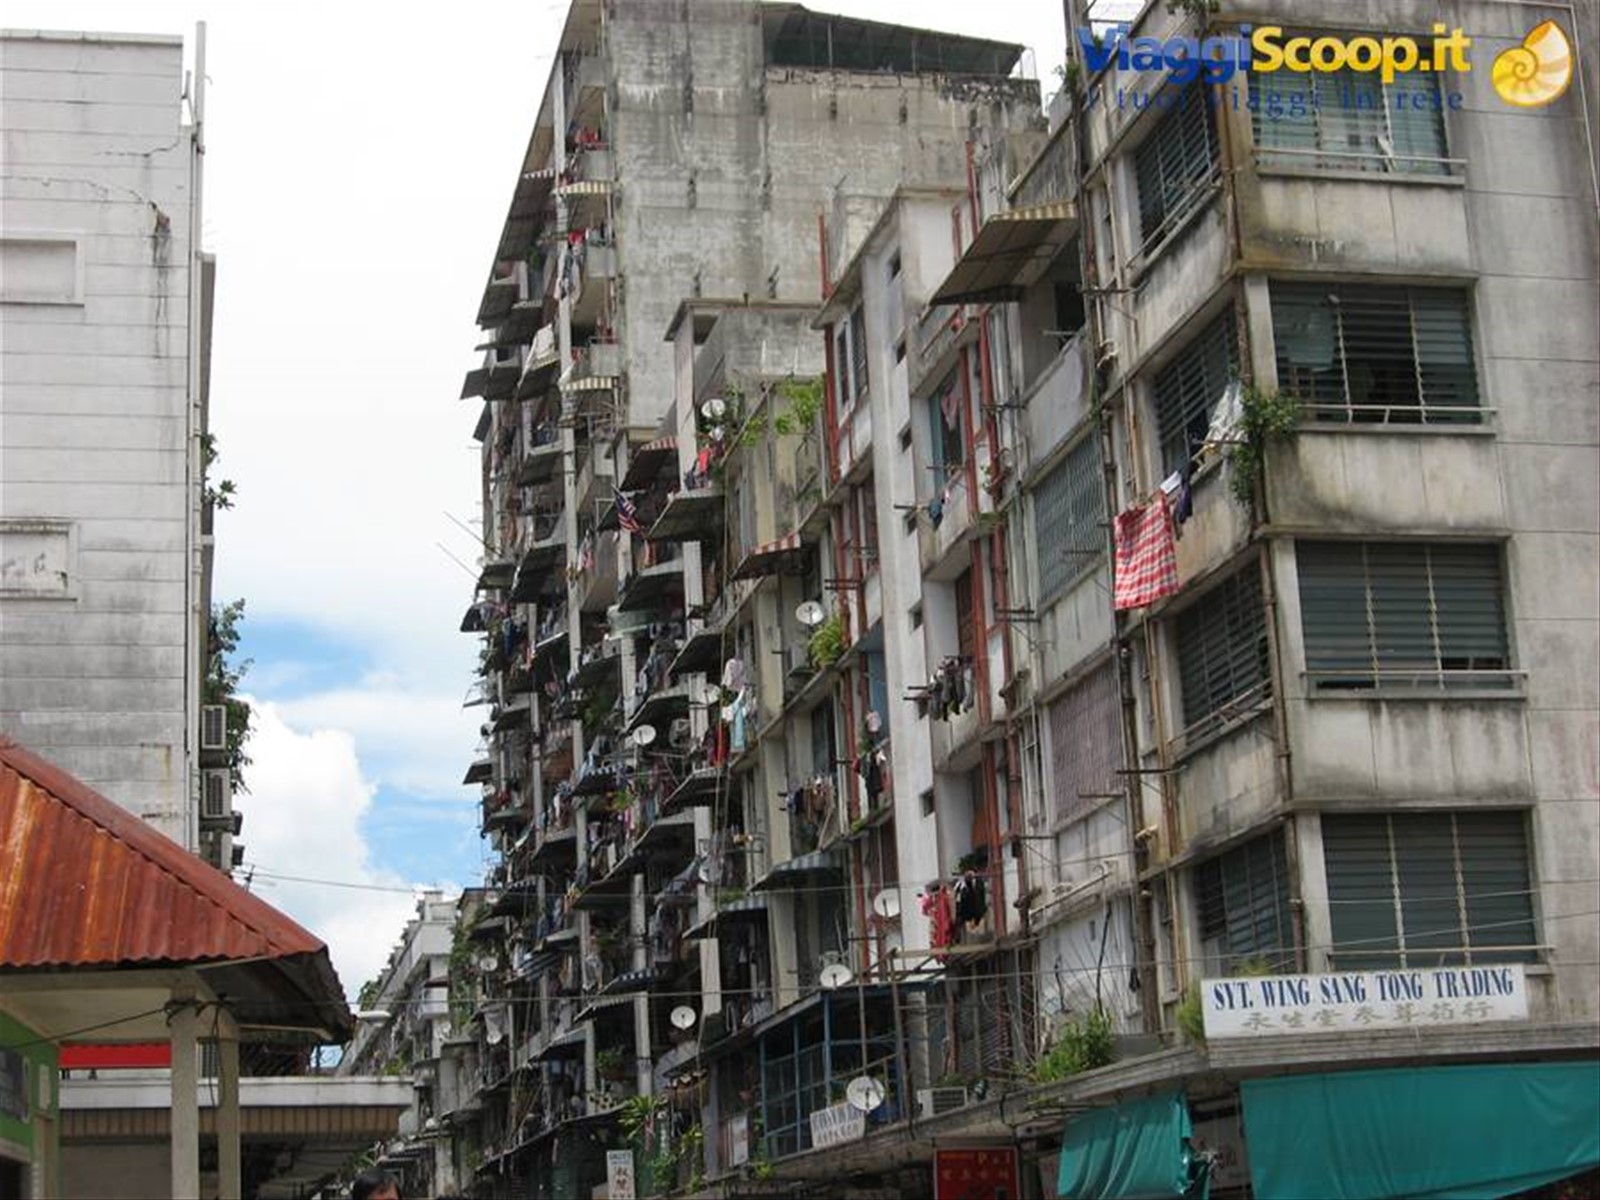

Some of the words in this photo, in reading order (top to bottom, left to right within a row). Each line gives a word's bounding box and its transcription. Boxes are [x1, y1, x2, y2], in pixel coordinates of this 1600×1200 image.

[1213, 982, 1254, 1010] SYT.
[1260, 979, 1310, 1008] WING
[1319, 975, 1366, 1005] SANG
[1375, 972, 1423, 1002] TONG
[1435, 968, 1515, 999] TRADING
